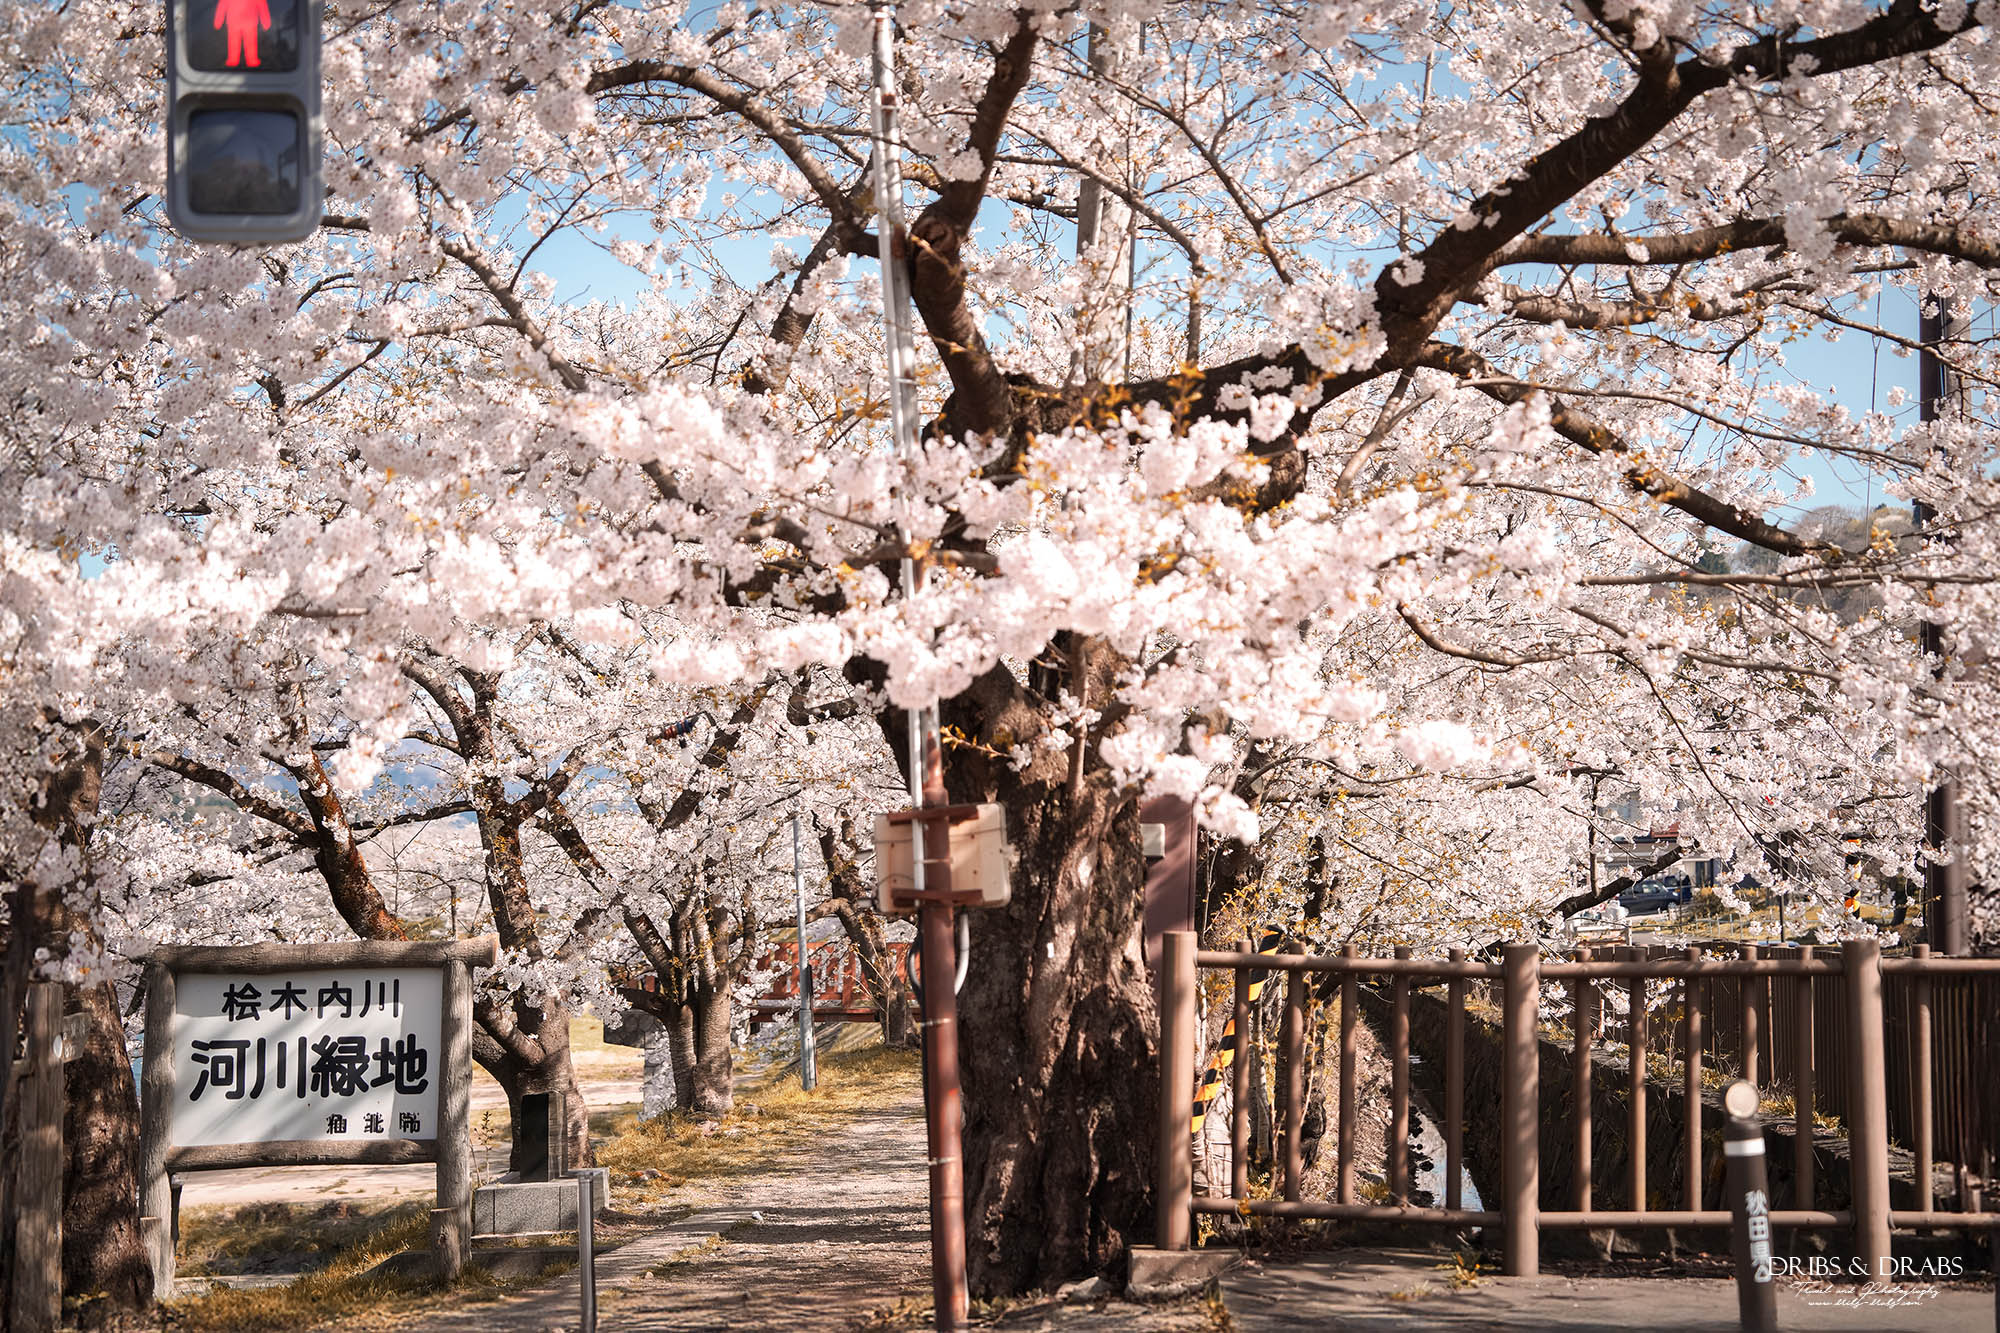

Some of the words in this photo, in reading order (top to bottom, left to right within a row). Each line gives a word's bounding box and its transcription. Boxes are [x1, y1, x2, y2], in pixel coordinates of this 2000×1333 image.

[221, 979, 399, 1021] 桧木内川
[189, 1033, 428, 1101] 河川緑地
